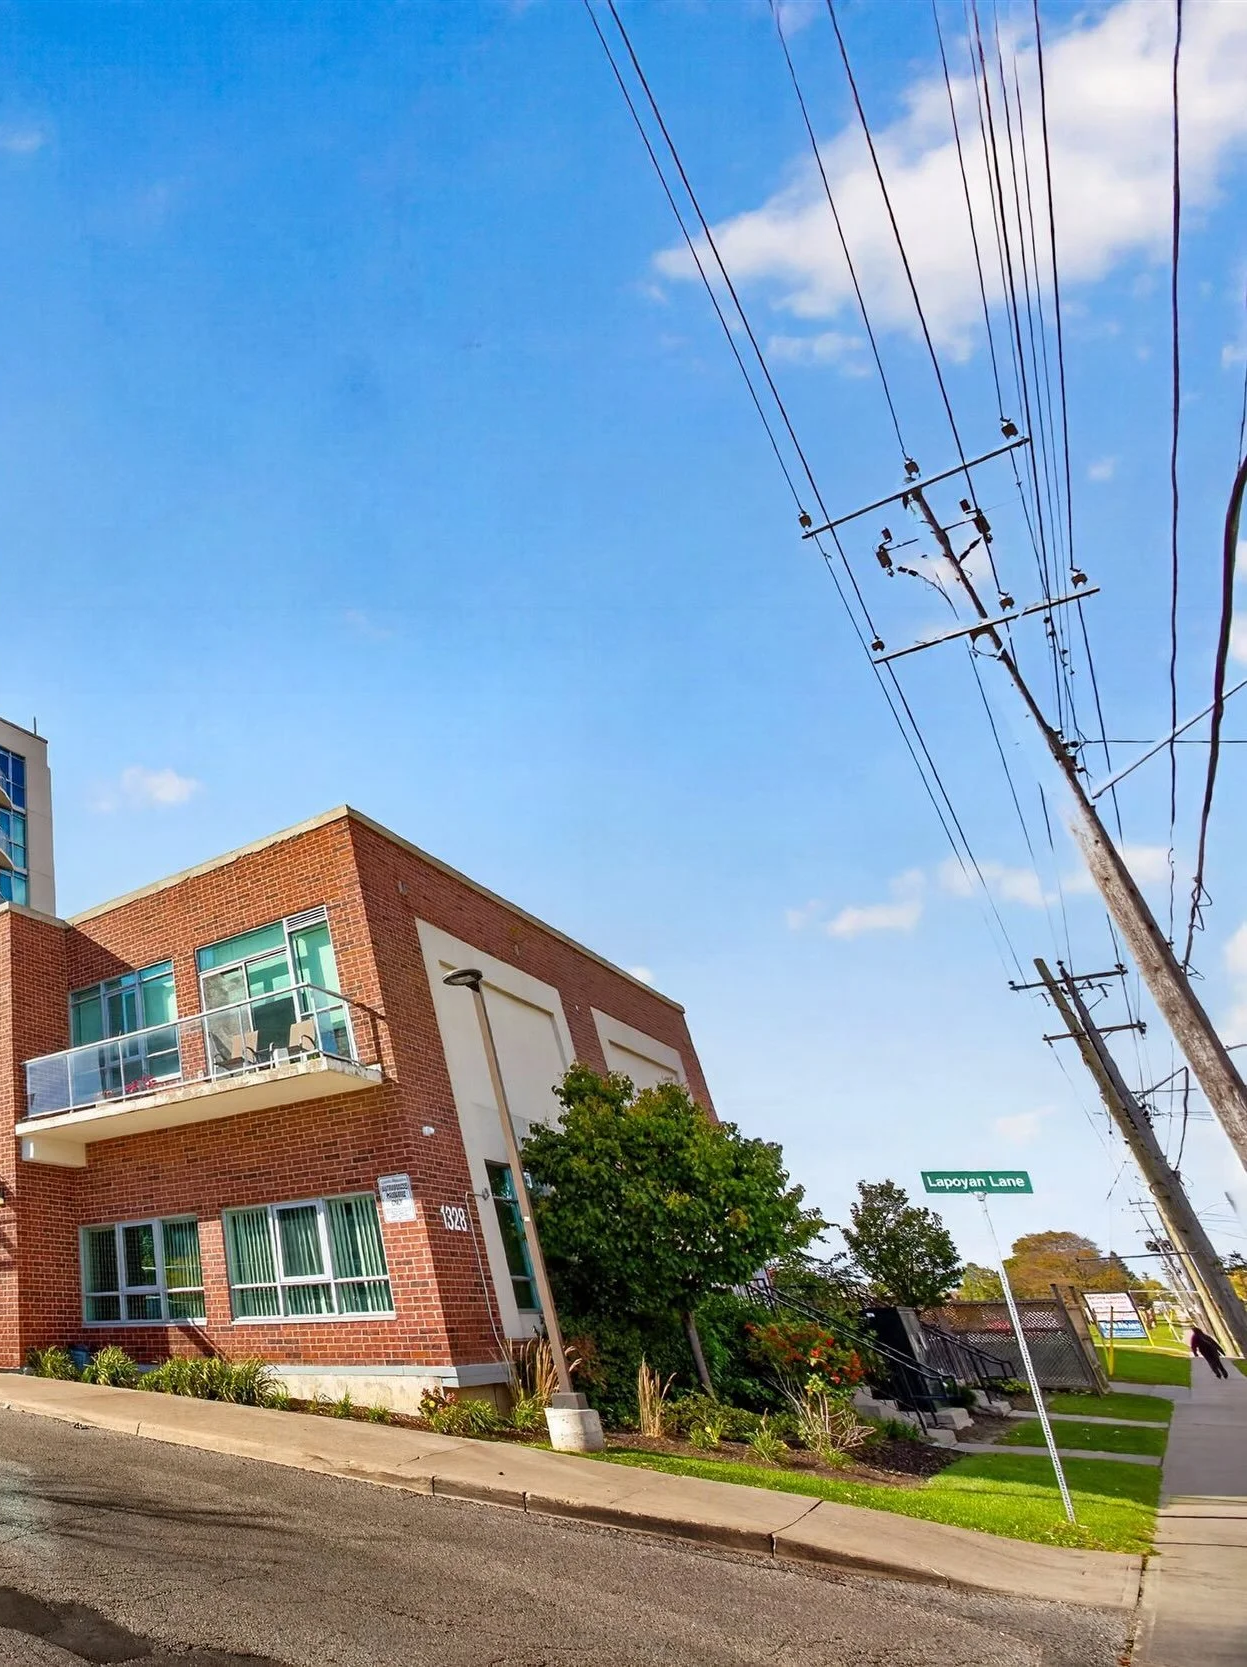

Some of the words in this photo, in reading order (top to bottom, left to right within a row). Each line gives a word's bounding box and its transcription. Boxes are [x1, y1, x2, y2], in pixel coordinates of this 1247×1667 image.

[926, 1176, 986, 1189] Lapoyan
[989, 1175, 1025, 1187] Lane
[440, 1204, 468, 1232] 1328
